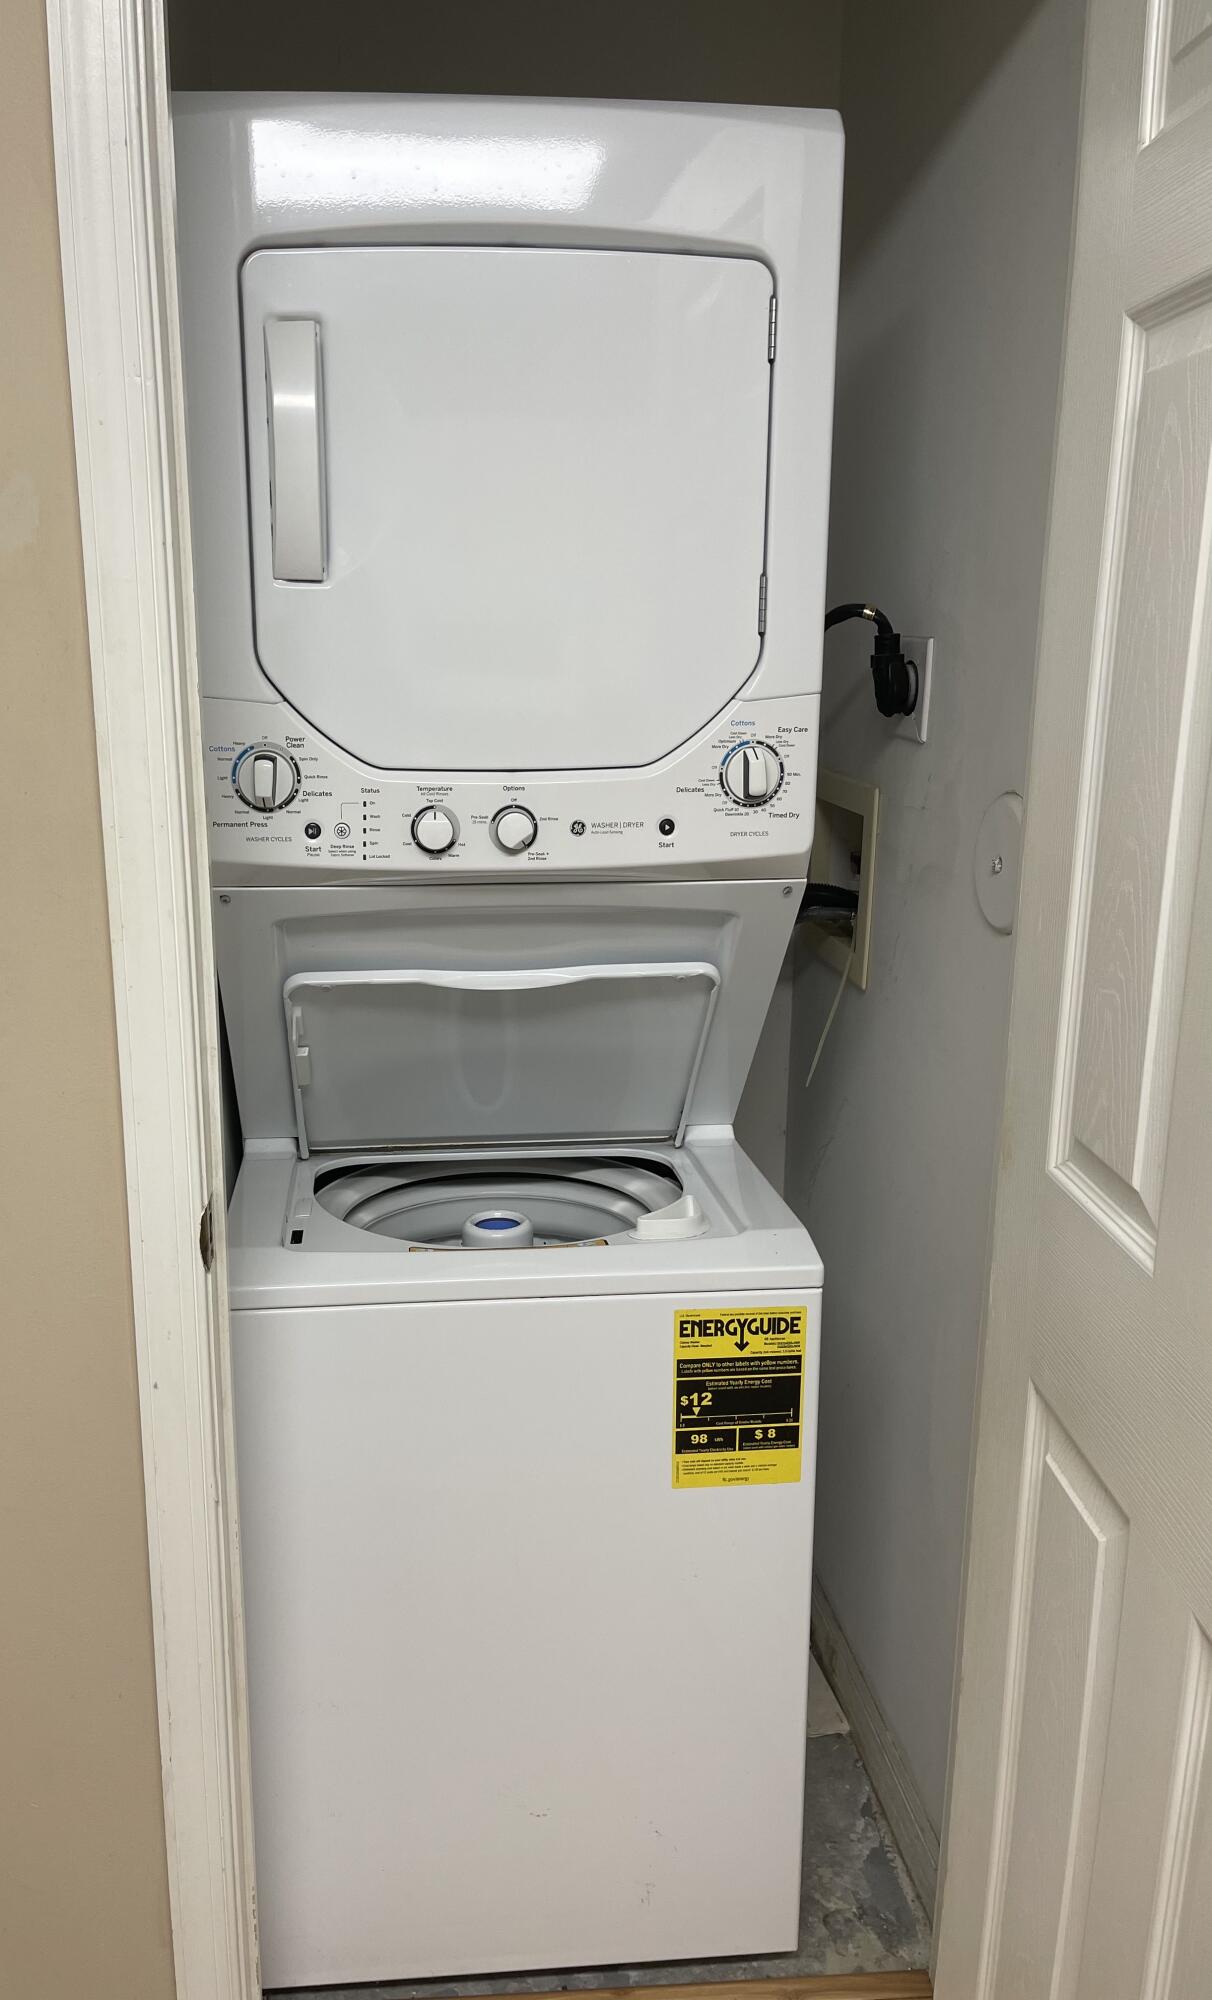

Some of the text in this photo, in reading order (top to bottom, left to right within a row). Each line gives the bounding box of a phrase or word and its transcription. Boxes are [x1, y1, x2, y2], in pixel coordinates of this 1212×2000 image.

[680, 1317, 801, 1338] ENERGYGUIDE
[680, 1392, 712, 1406] $12
[691, 1434, 708, 1444] 98
[755, 1429, 776, 1440] $ 8
